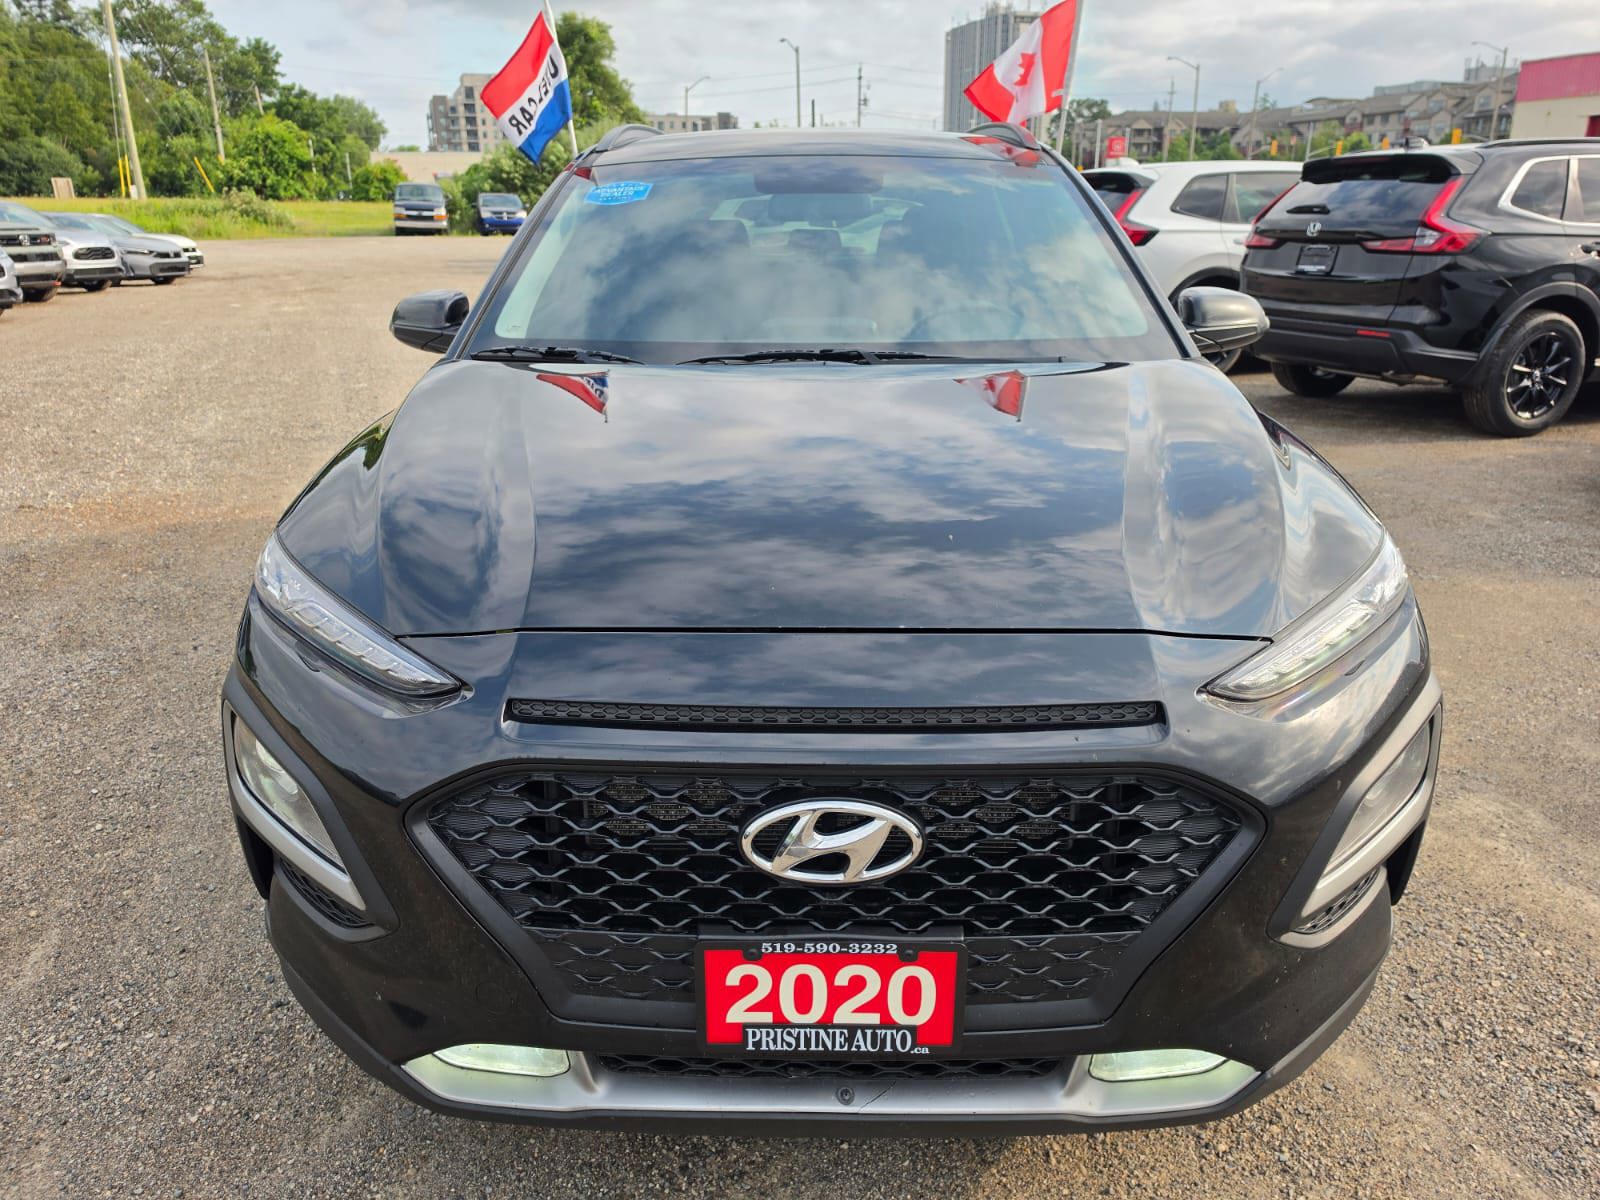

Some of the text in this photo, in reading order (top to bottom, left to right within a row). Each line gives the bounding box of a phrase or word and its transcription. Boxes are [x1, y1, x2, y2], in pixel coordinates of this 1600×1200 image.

[761, 942, 898, 954] 519-590-3232
[725, 963, 937, 1026] 2020
[745, 1027, 849, 1052] PRISTINE
